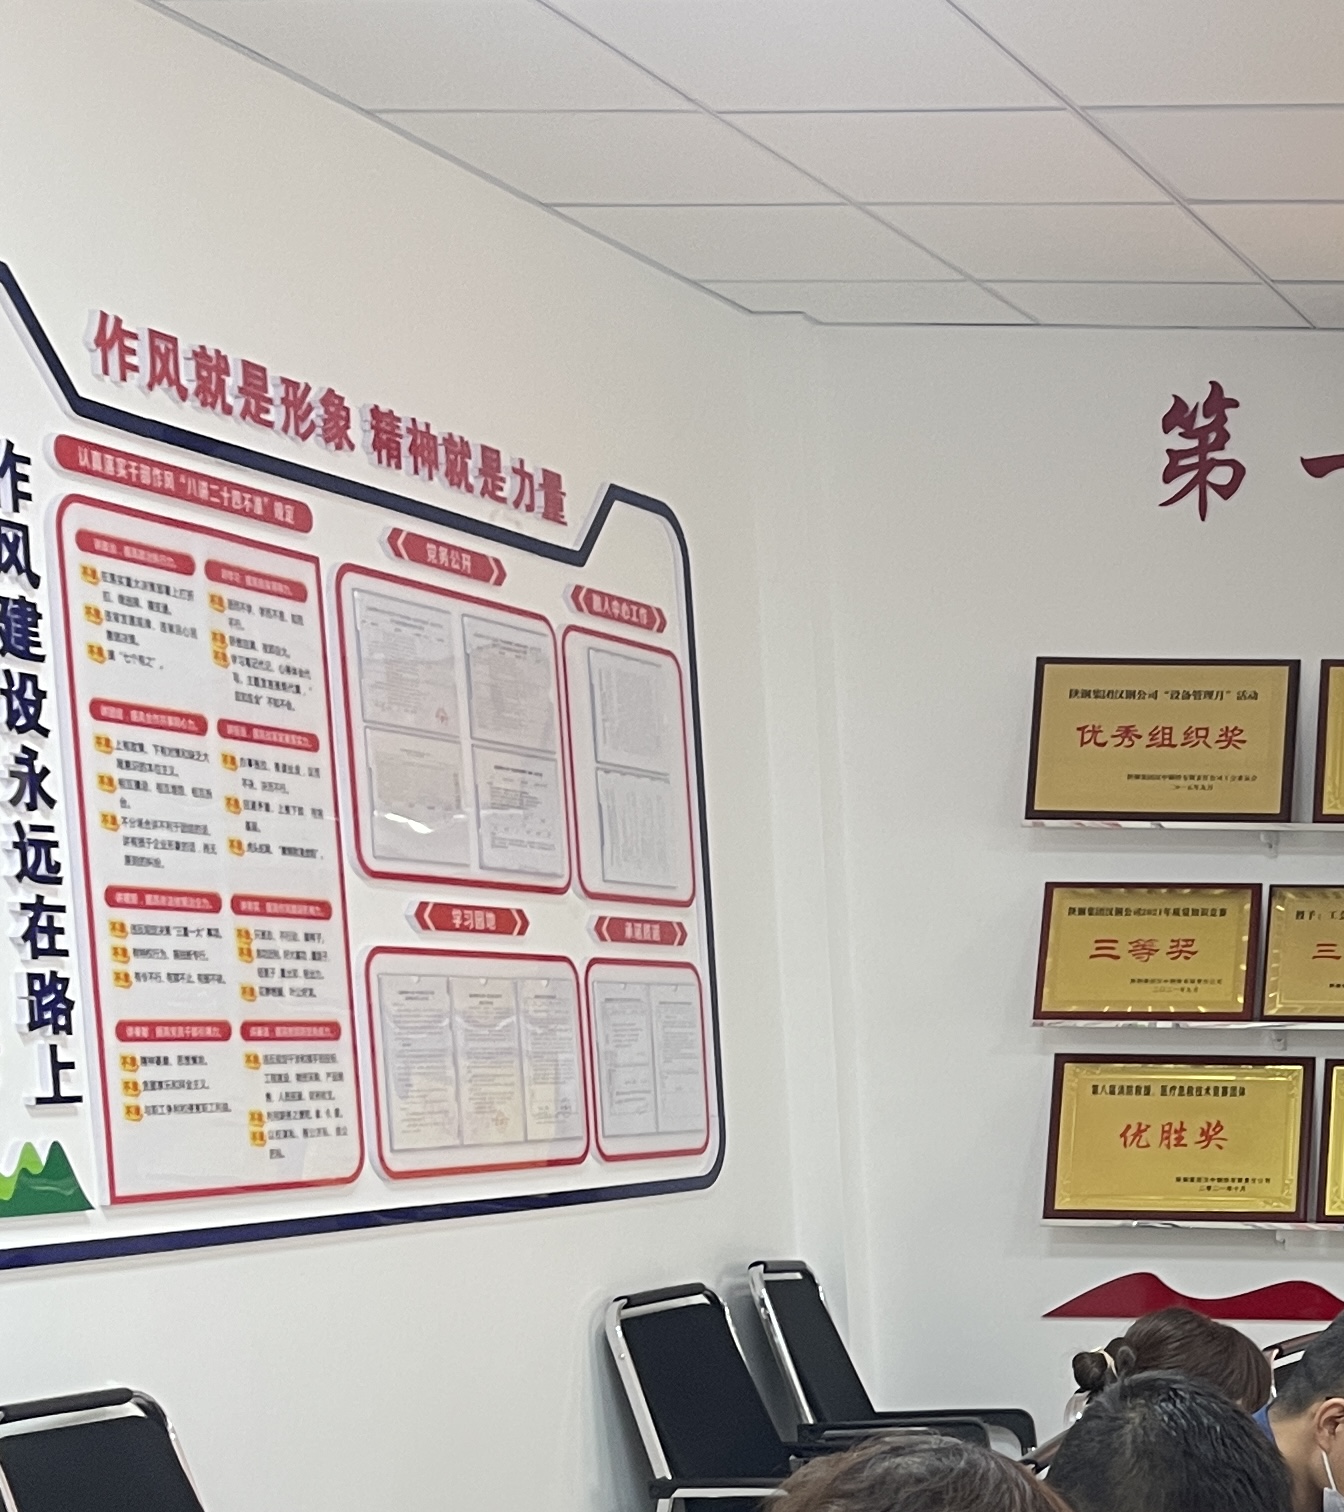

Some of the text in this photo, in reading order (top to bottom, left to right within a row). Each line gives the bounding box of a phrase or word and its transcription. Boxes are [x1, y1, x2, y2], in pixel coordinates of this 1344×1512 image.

[95, 310, 567, 526] 作风就是形象 精神就是力量
[426, 543, 472, 574] 党务公开
[1076, 724, 1247, 750] 优秀组织奖
[0, 439, 84, 1106] 作风建设永远在路上
[1089, 938, 1199, 962] 三等奖
[1119, 1120, 1228, 1150] 优胜奖
